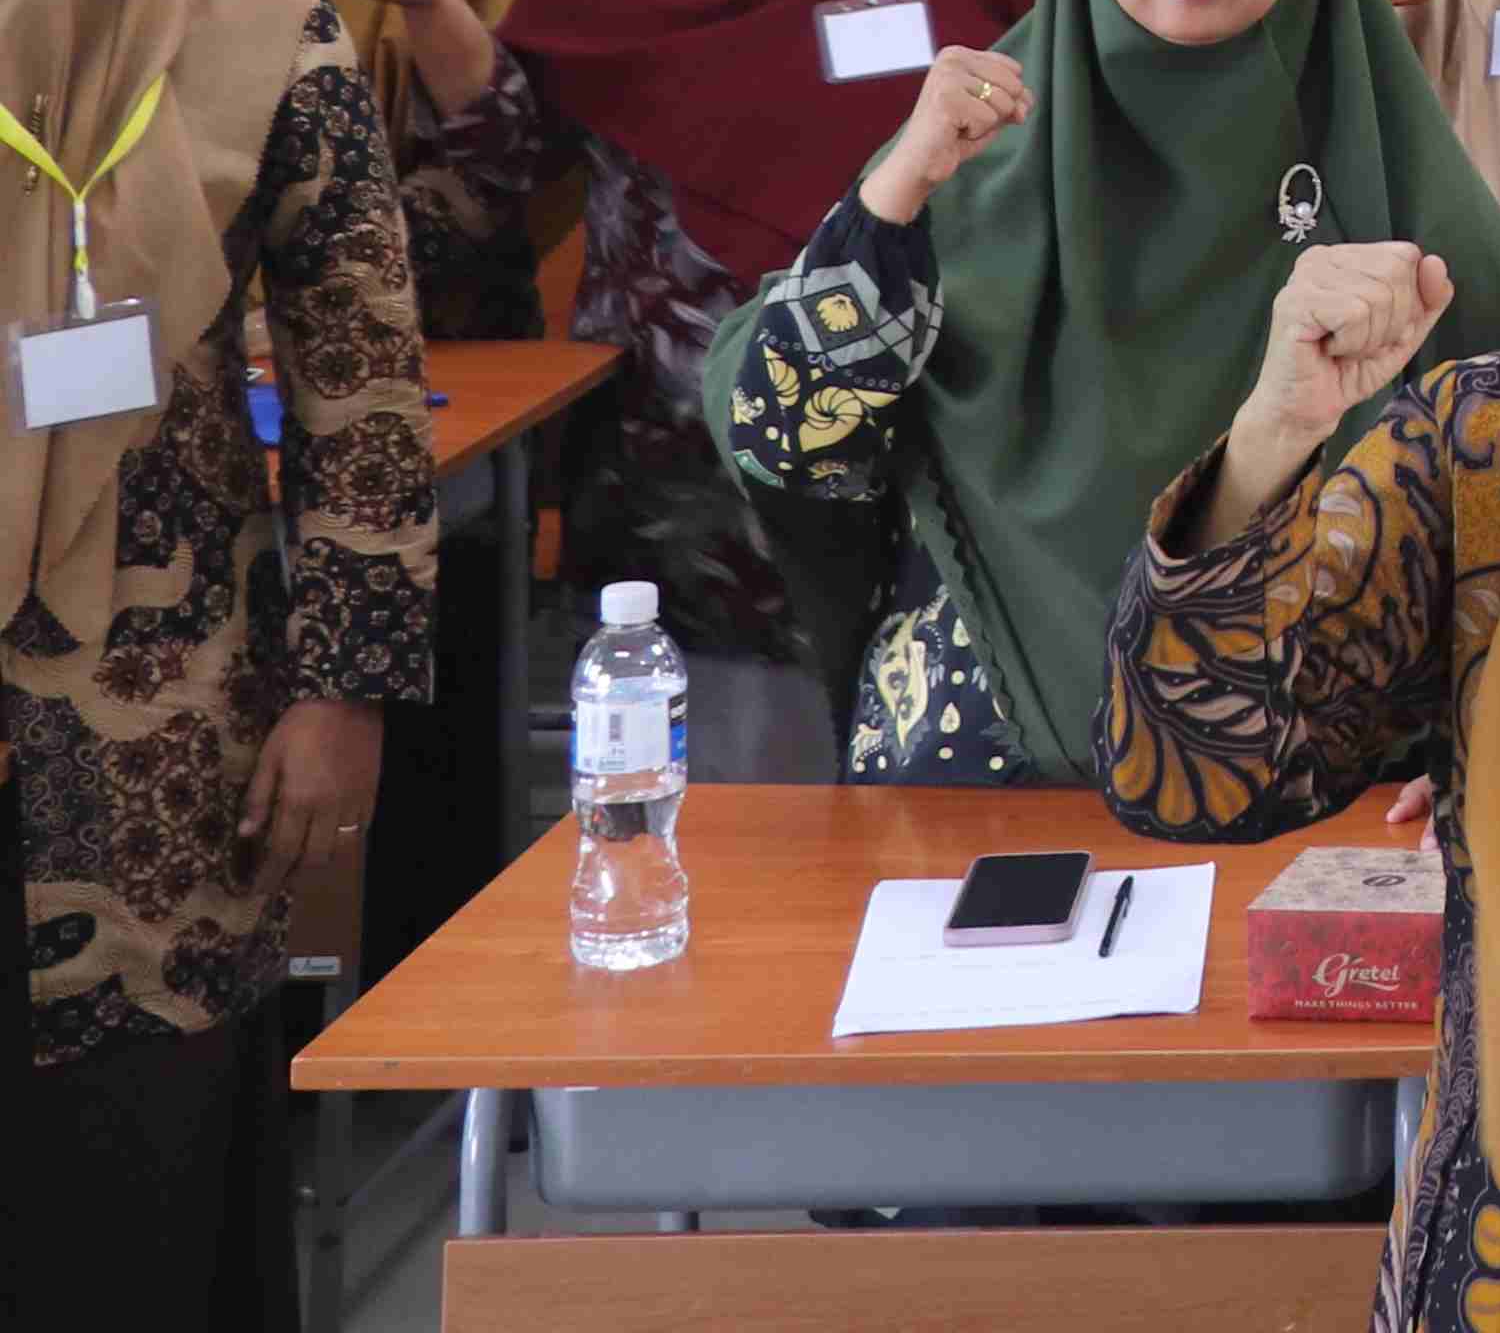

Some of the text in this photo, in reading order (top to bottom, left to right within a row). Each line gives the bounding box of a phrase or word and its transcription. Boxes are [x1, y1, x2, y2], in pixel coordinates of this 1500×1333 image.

[1312, 953, 1400, 998] Gretel
[1295, 1000, 1418, 1010] MAKE THINGS BETTER
